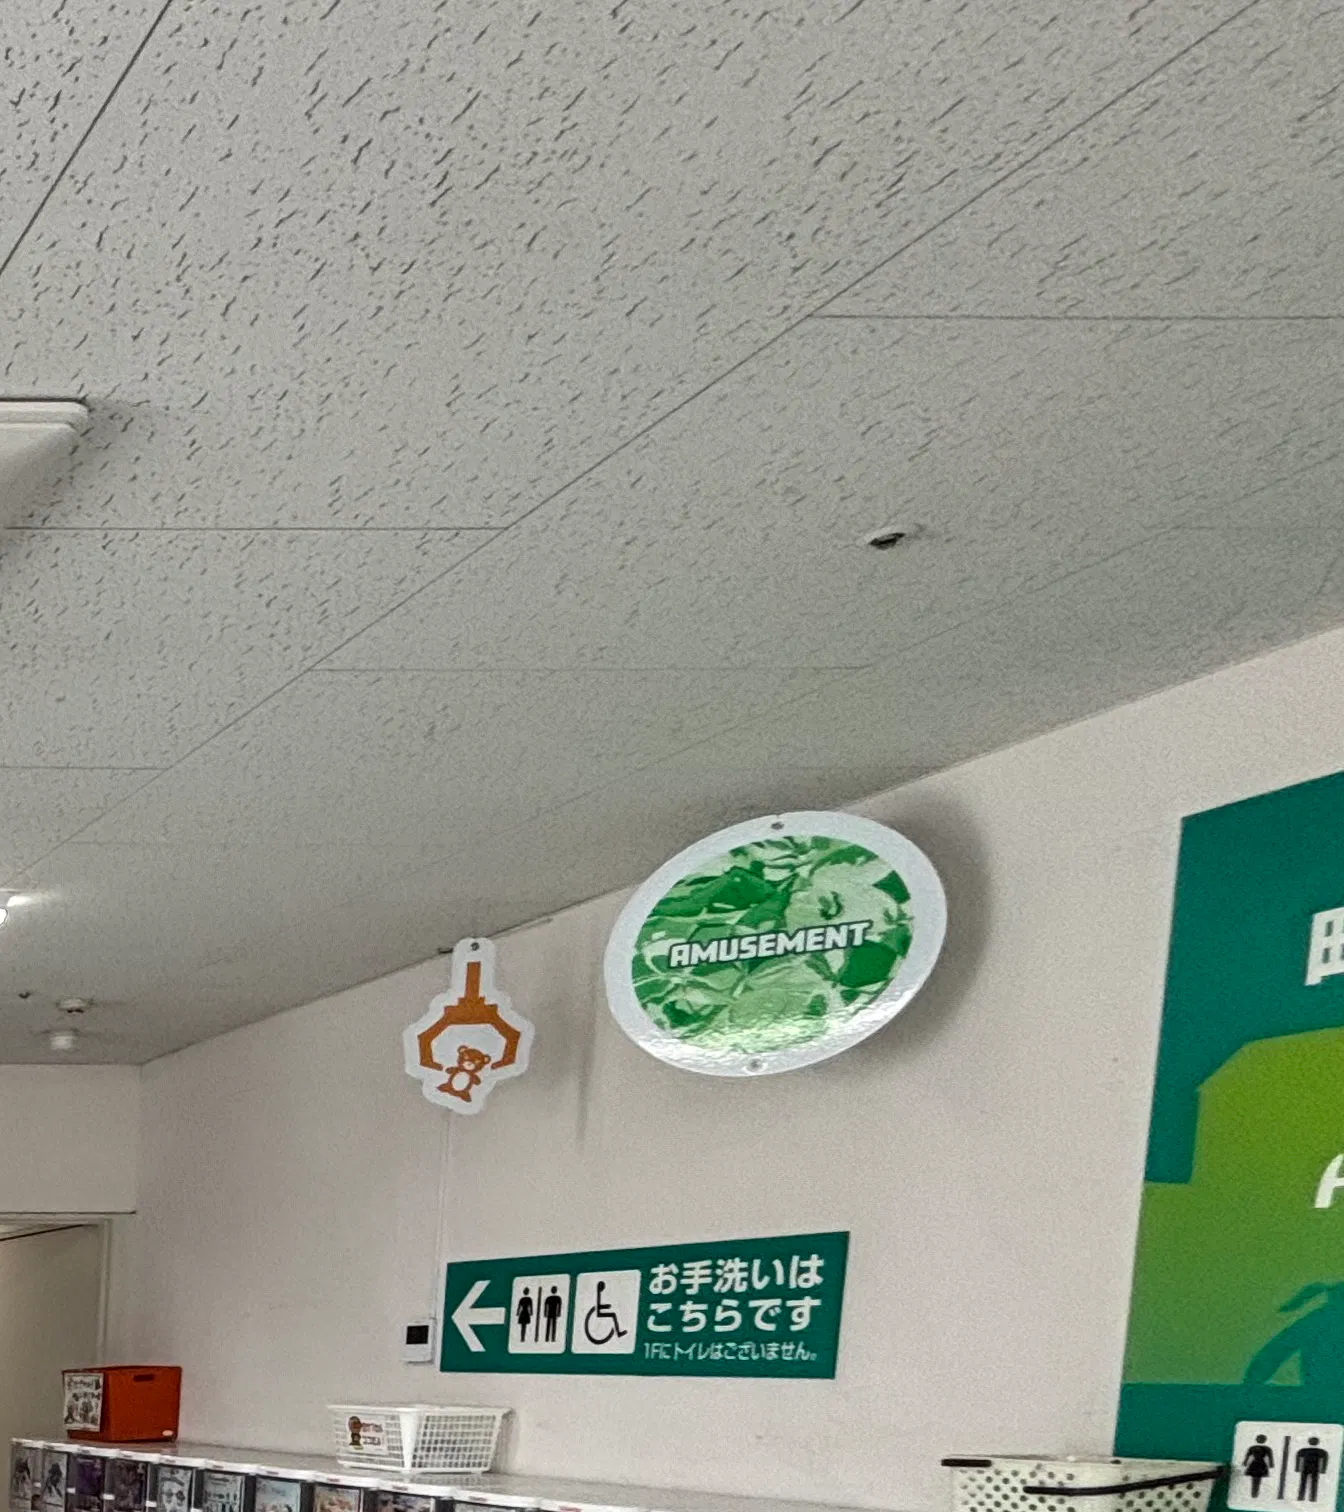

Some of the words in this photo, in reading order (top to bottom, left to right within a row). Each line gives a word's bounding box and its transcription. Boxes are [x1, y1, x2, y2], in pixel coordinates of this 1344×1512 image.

[670, 920, 872, 968] AMUSEMENT
[648, 1254, 825, 1296] お手洗いは
[647, 1296, 822, 1332] こちらです
